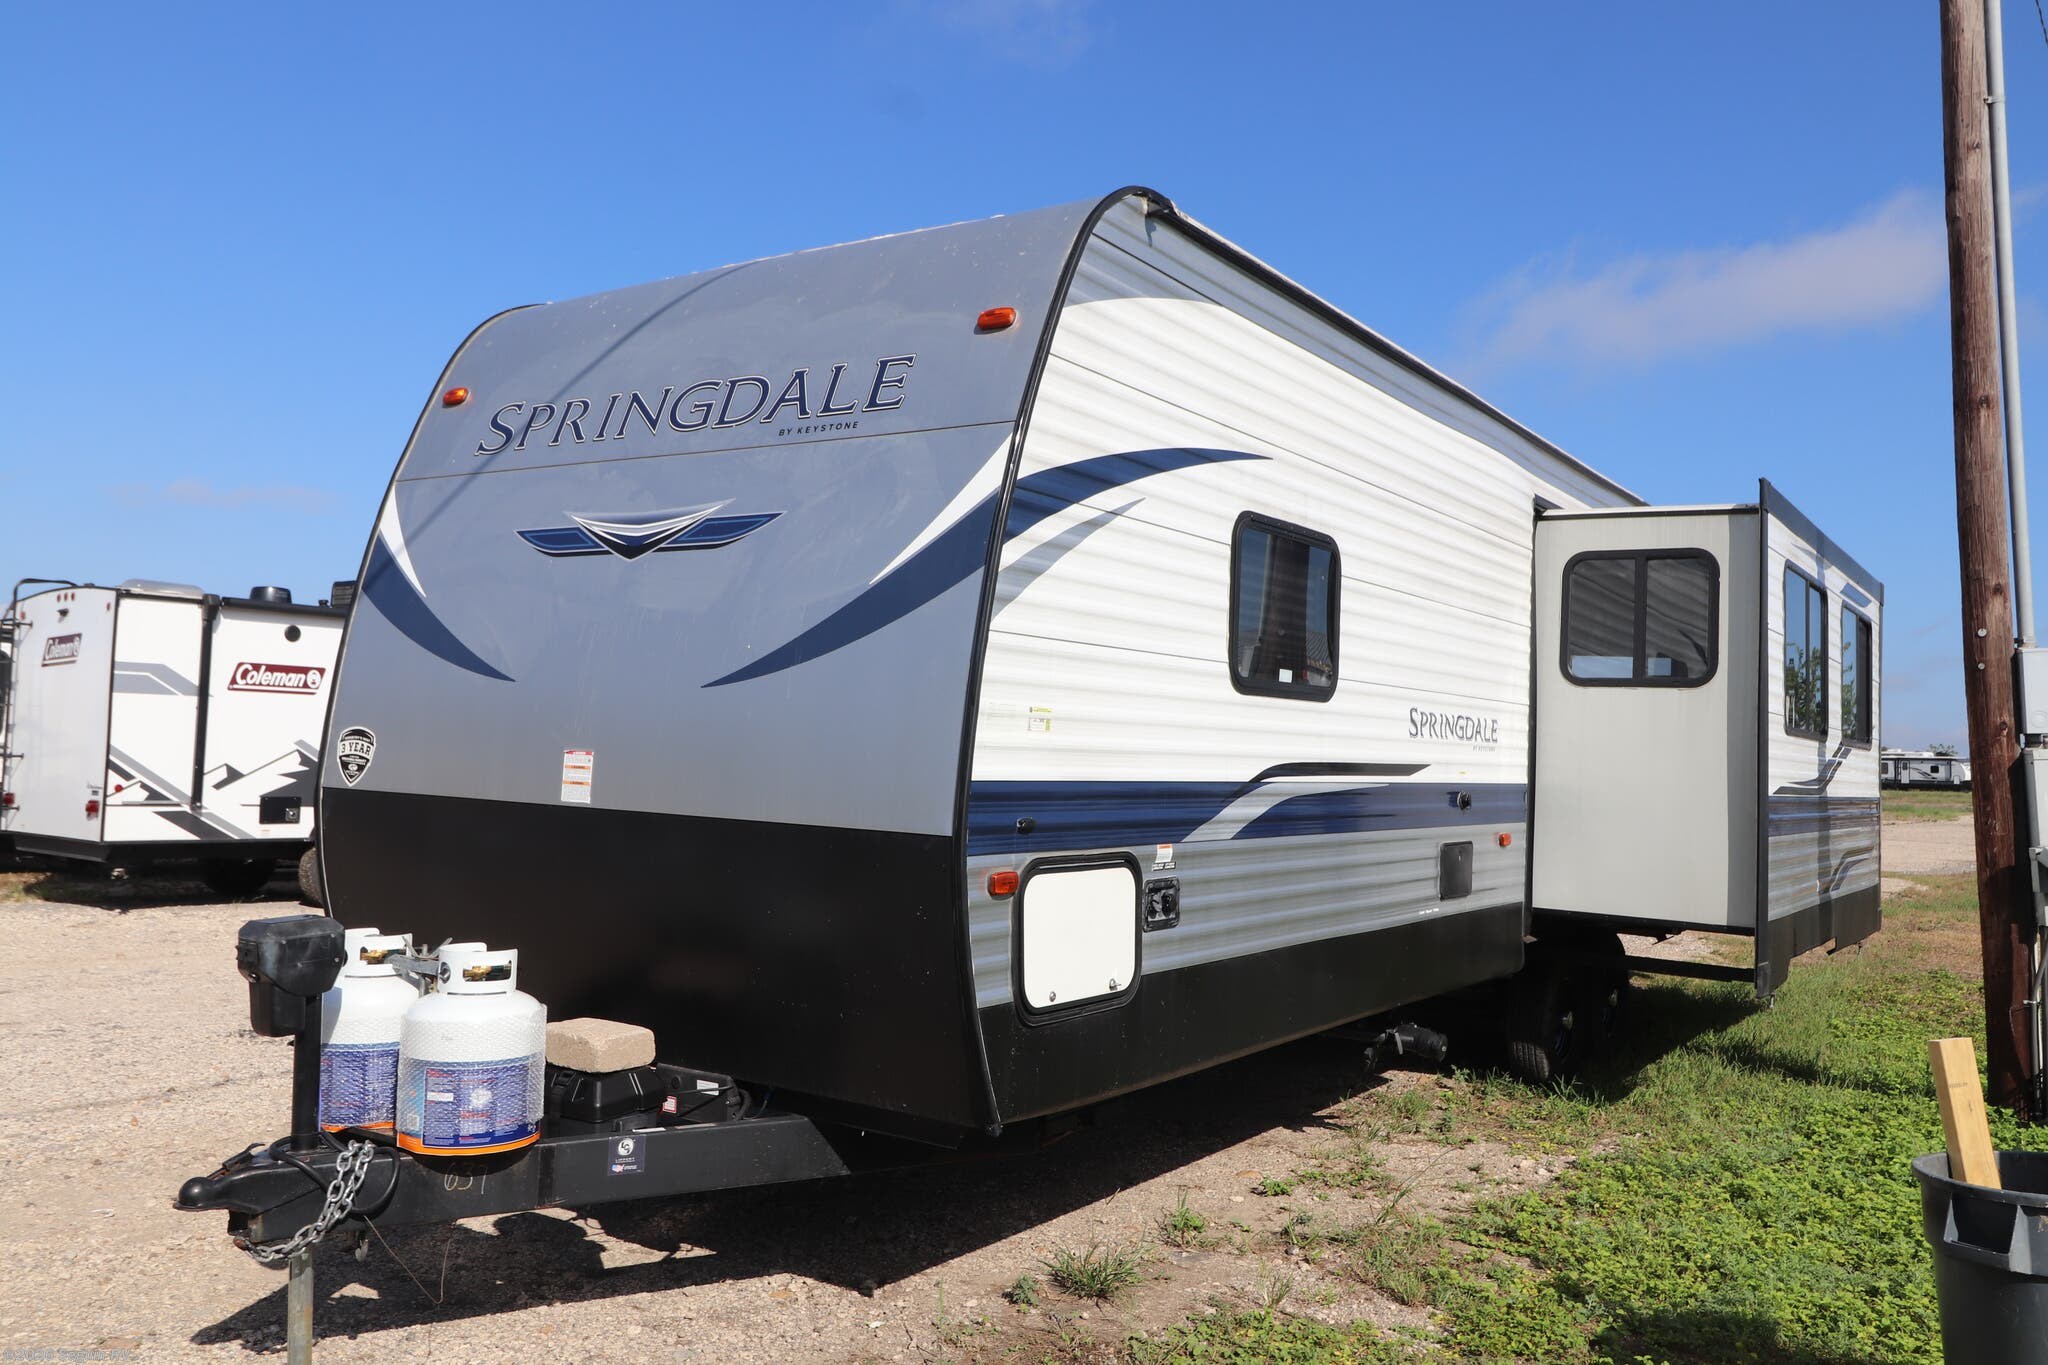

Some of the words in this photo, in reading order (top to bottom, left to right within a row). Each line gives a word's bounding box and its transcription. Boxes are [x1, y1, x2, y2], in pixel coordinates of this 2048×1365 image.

[474, 353, 917, 456] SPRINGDALE
[778, 428, 793, 437] BY
[796, 421, 859, 435] KEYSTONE
[235, 663, 306, 688] Coleman
[1409, 707, 1498, 743] SPRINGDALE
[348, 741, 372, 756] YEAR
